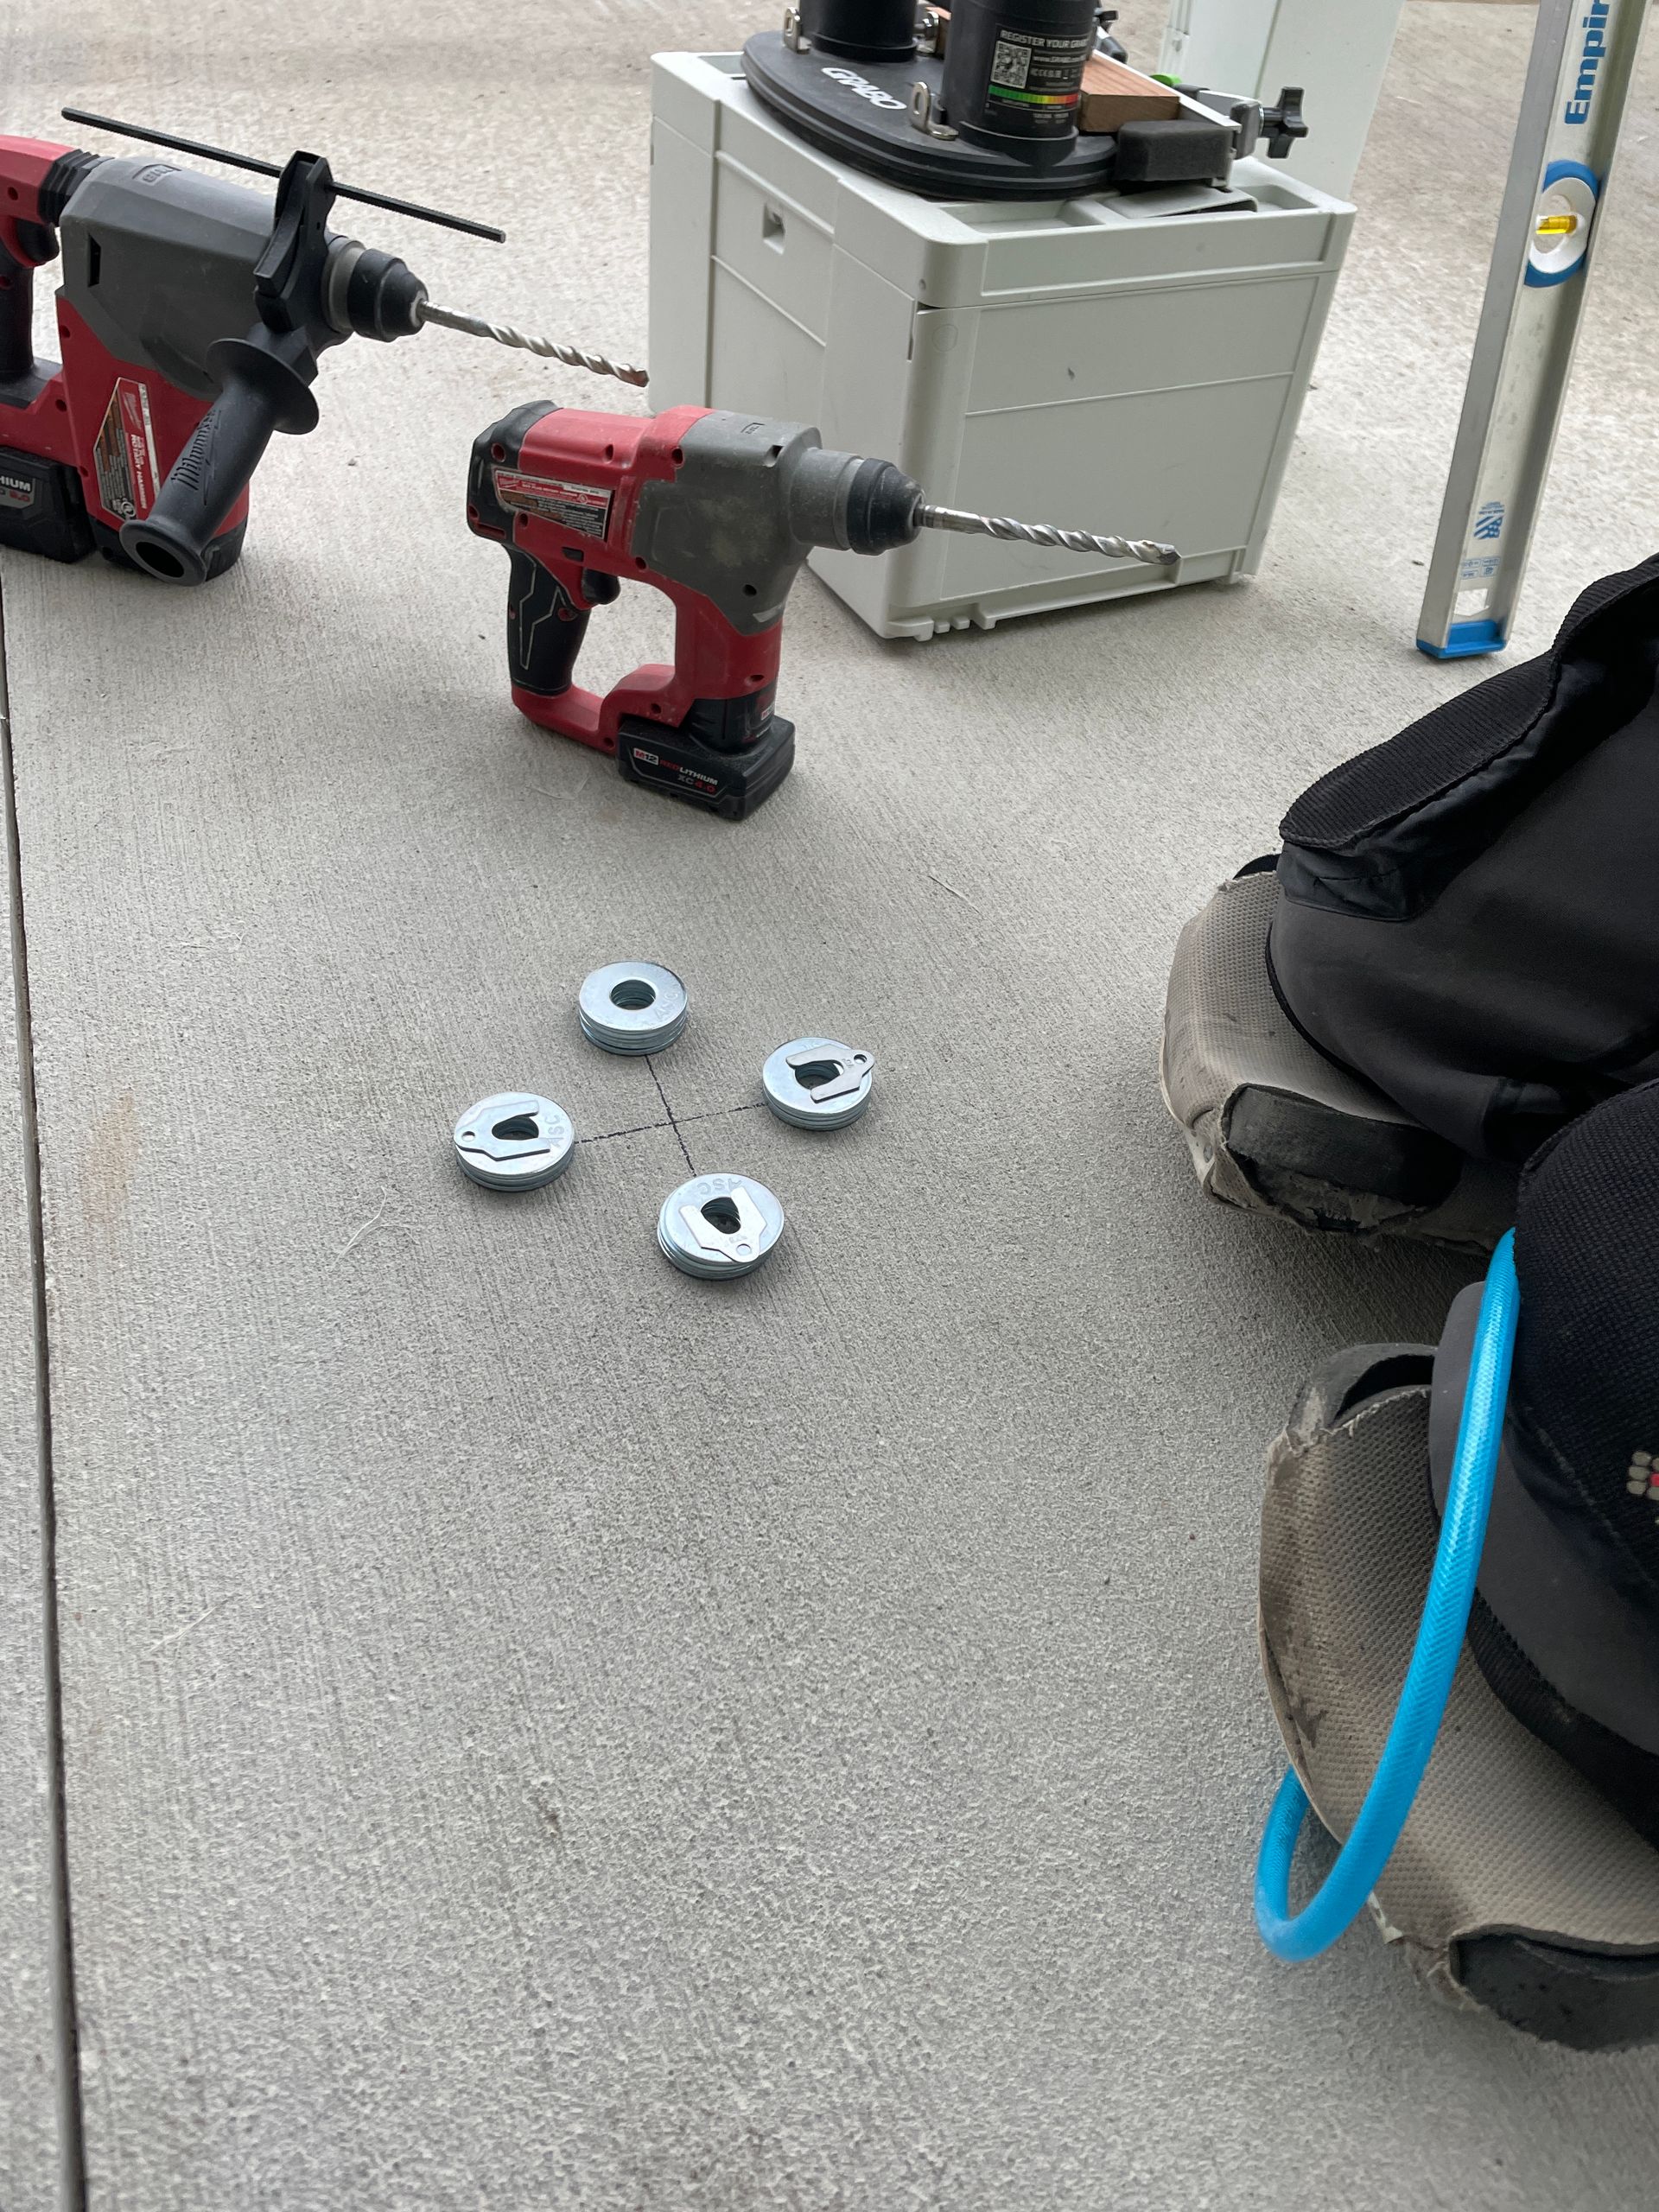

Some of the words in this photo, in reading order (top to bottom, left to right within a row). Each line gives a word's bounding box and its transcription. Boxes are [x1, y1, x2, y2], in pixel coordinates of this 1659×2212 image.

[1000, 29, 1046, 48] REGISTER
[1046, 38, 1071, 48] YOUR
[821, 67, 907, 110] GRABO
[634, 749, 658, 765] M12
